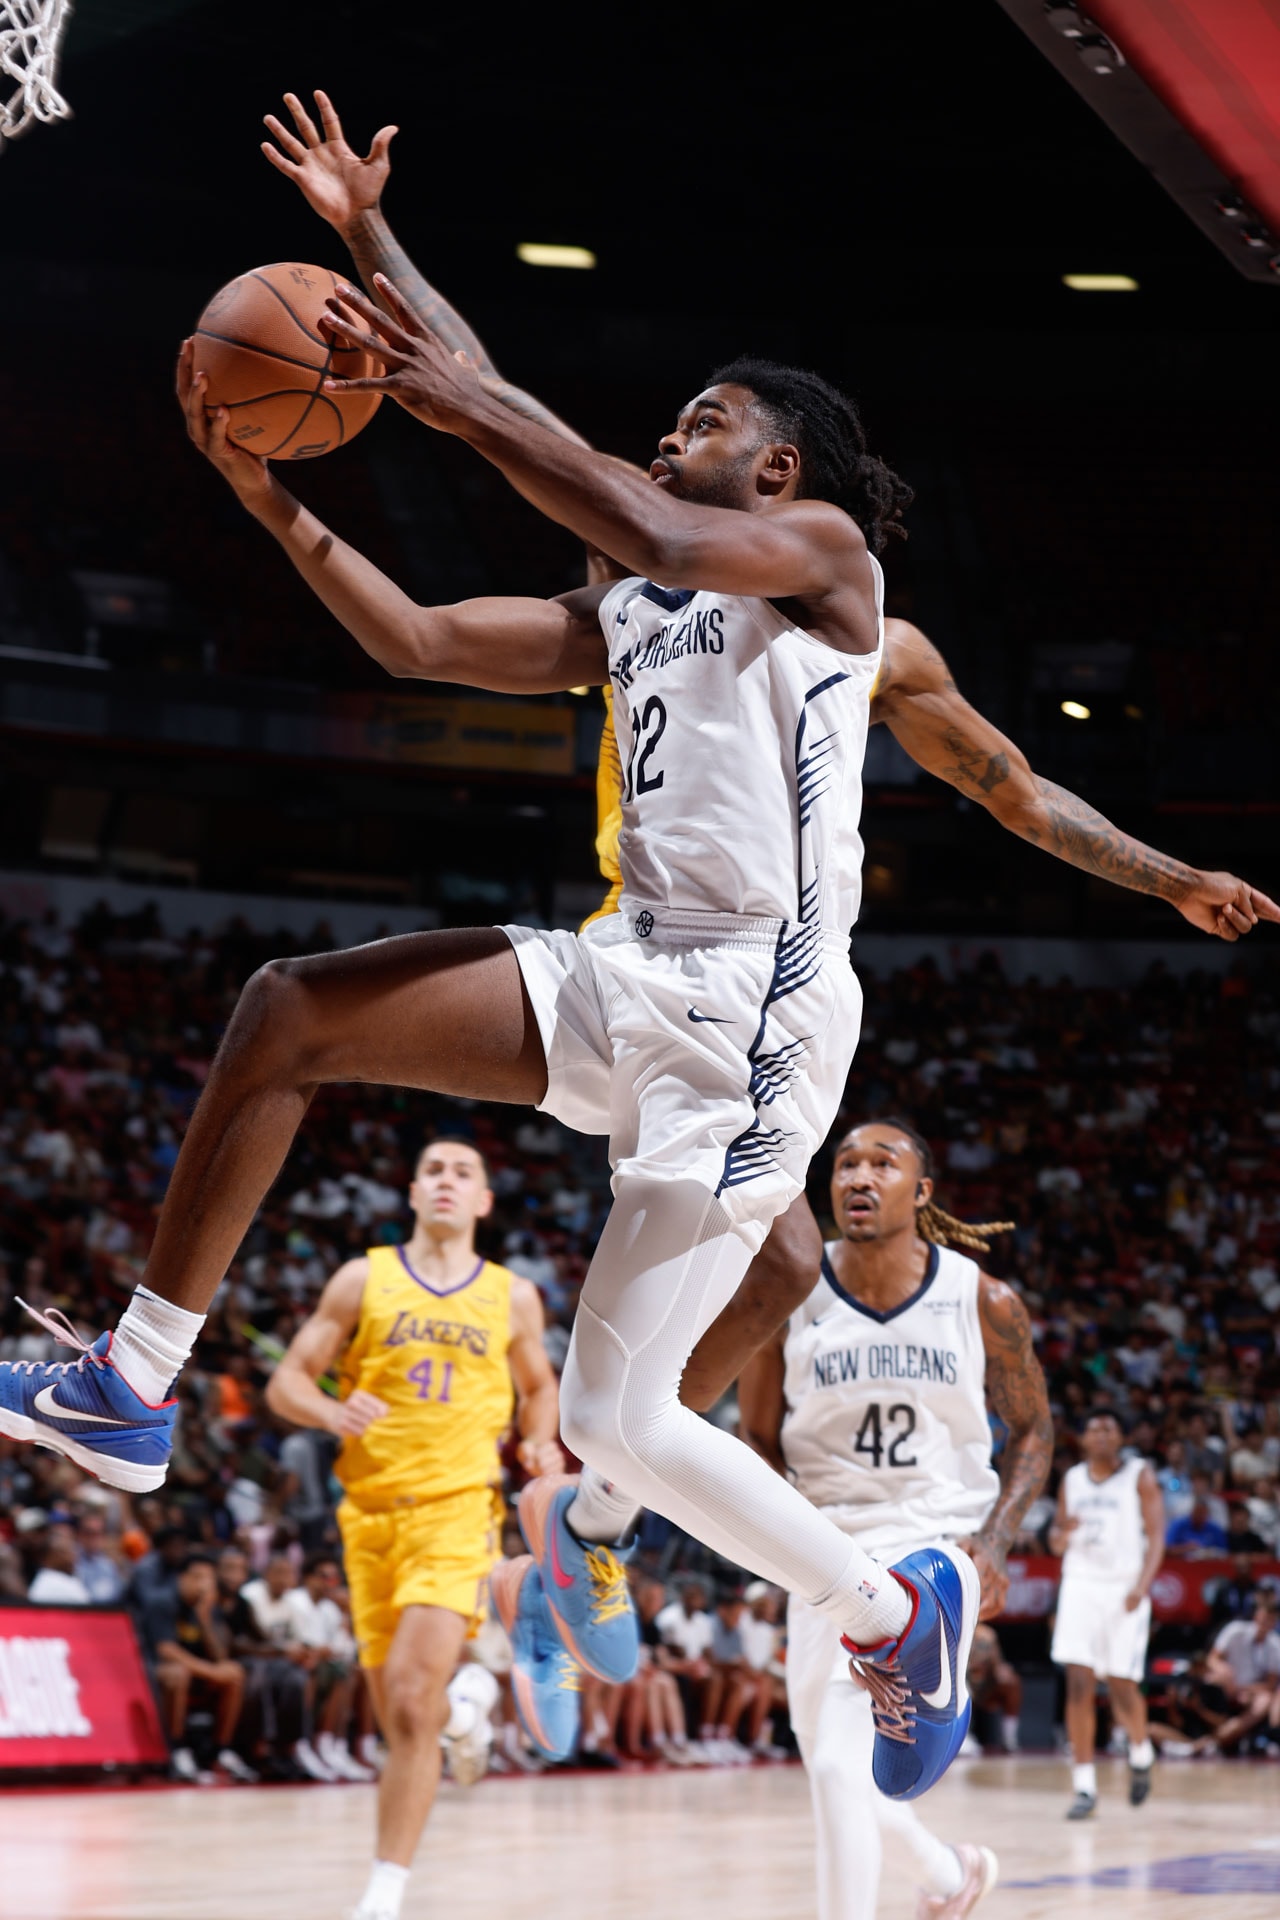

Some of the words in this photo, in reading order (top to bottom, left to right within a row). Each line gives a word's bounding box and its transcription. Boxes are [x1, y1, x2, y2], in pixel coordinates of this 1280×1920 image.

[625, 694, 667, 803] 12
[382, 1310, 490, 1356] LAKERS
[407, 1358, 453, 1403] 41
[814, 1347, 859, 1389] NEW
[868, 1344, 957, 1386] ORLEANS
[854, 1403, 917, 1467] 42
